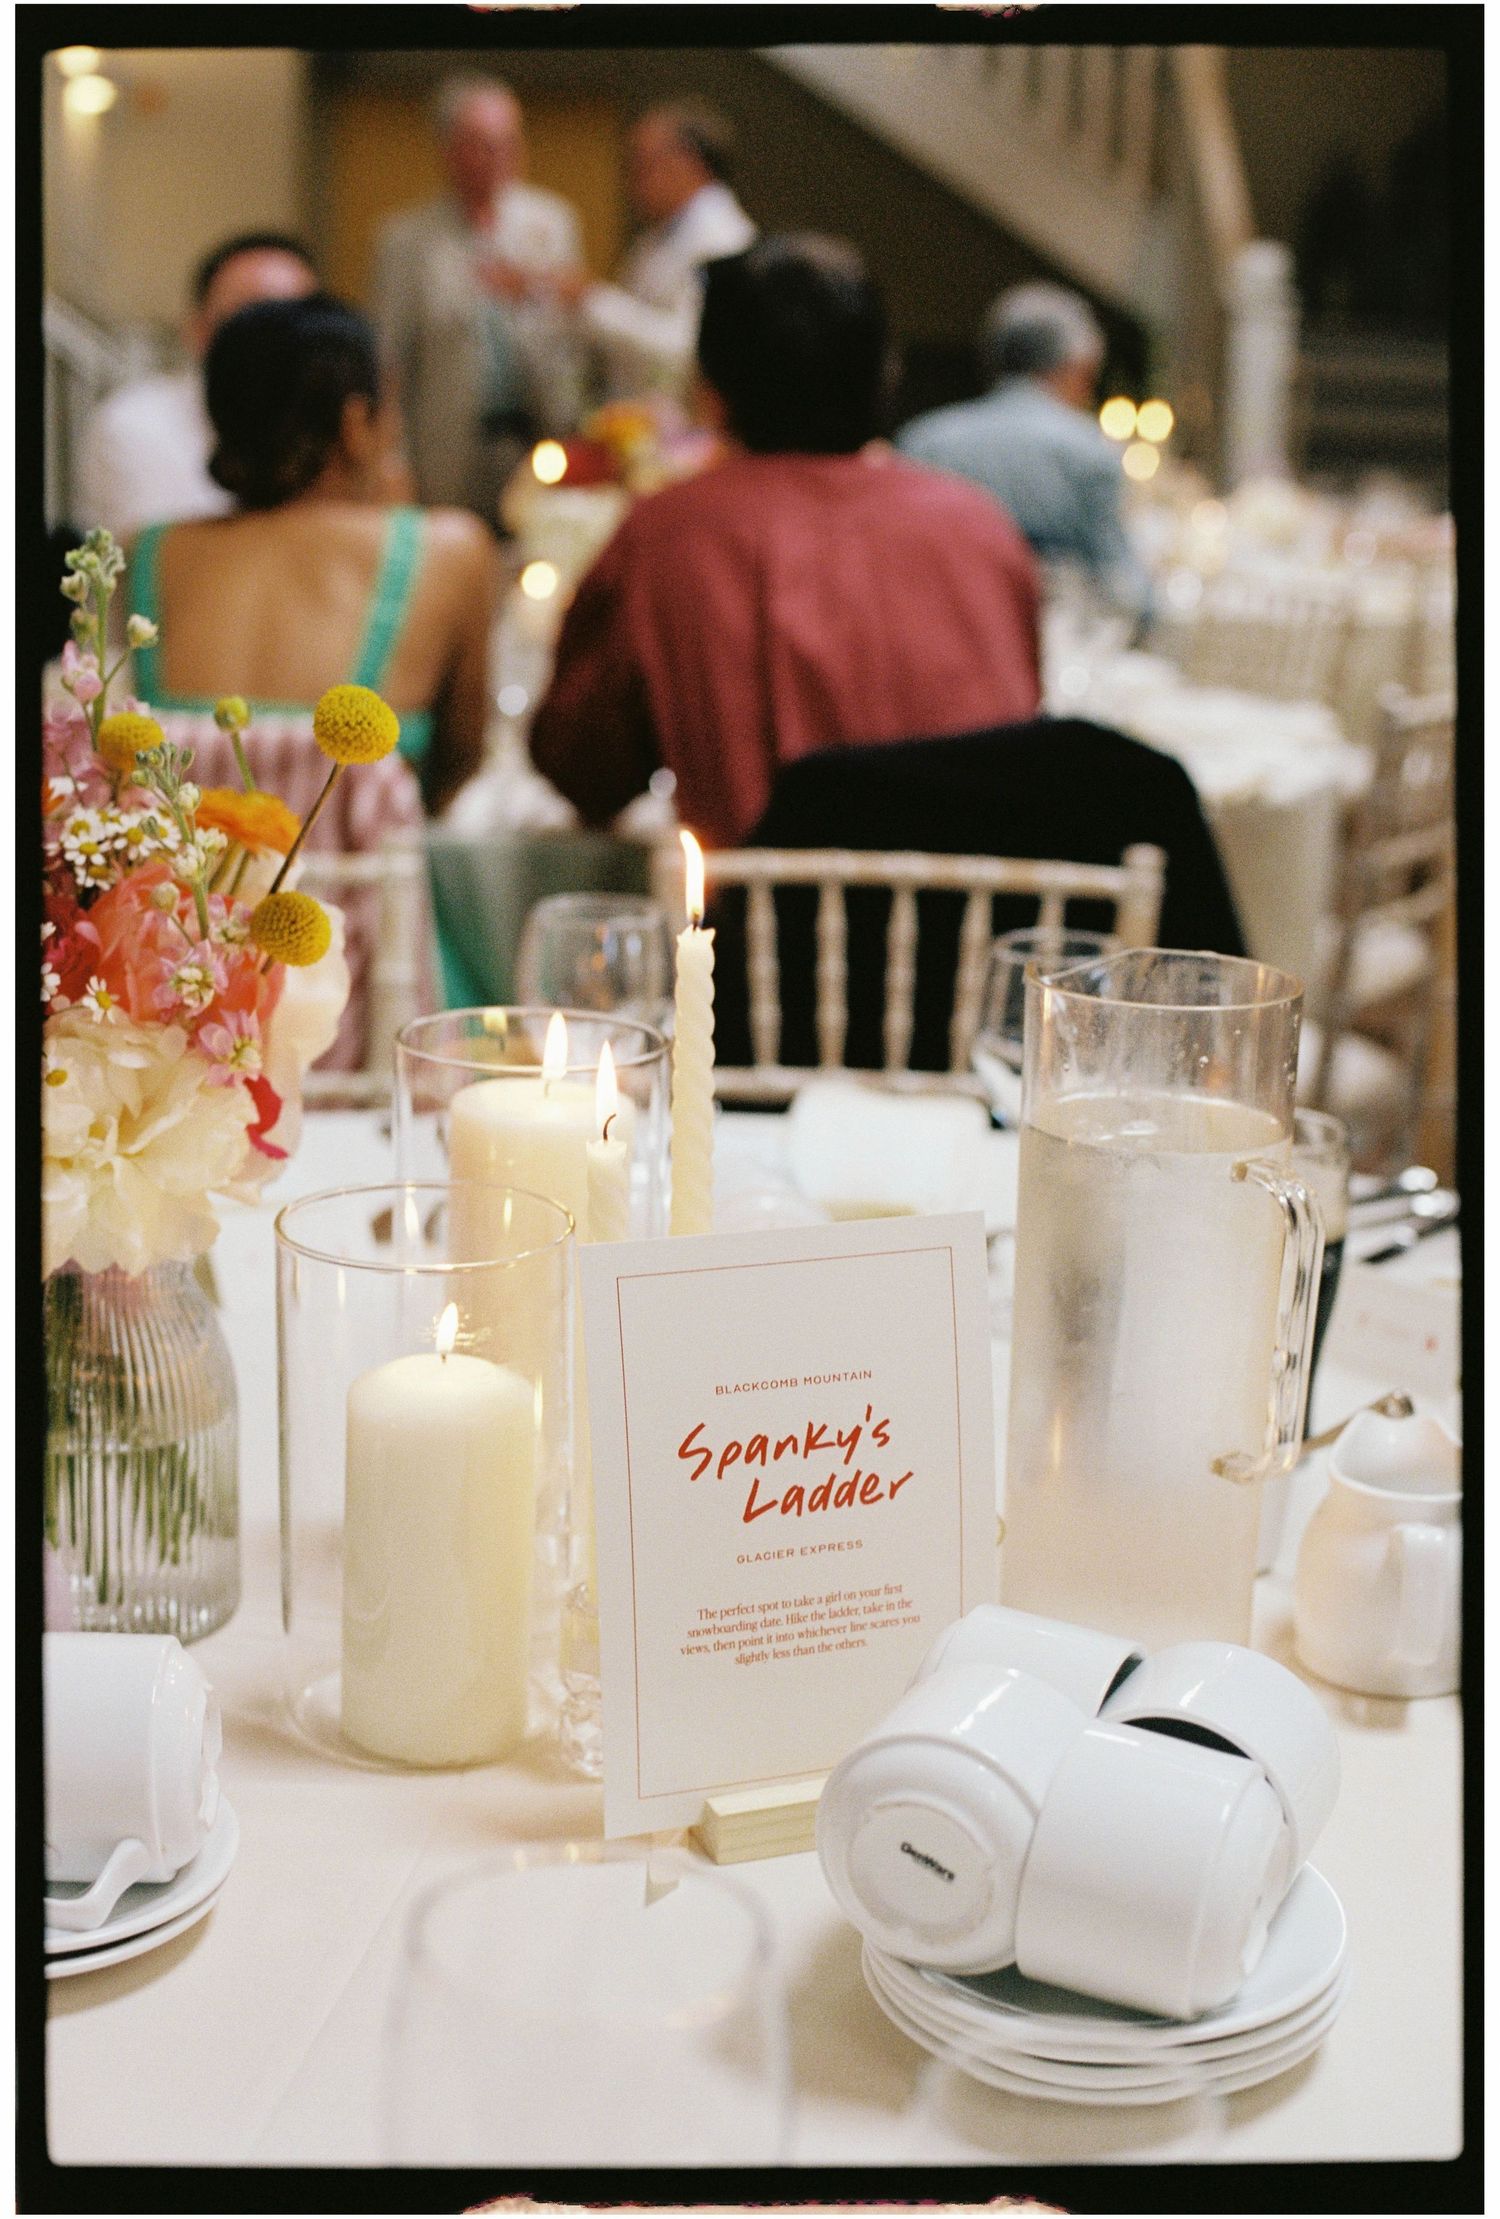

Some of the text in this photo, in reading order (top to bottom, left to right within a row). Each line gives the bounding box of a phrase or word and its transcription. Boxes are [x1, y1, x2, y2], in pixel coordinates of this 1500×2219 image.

[715, 1370, 873, 1396] BLACKCOMB MOUNTAIN
[678, 1403, 890, 1481] Spanky's
[743, 1469, 914, 1524] Ladder
[736, 1539, 864, 1565] GLACIER EXPRESS
[687, 1598, 913, 1638] snowboarding date. Hike the ladder, take in the
[697, 1584, 903, 1620] The perfect spot to take a girl on your first
[680, 1615, 921, 1656] views, then point it into whichever line scares you
[735, 1638, 867, 1666] slightly less than the others.
